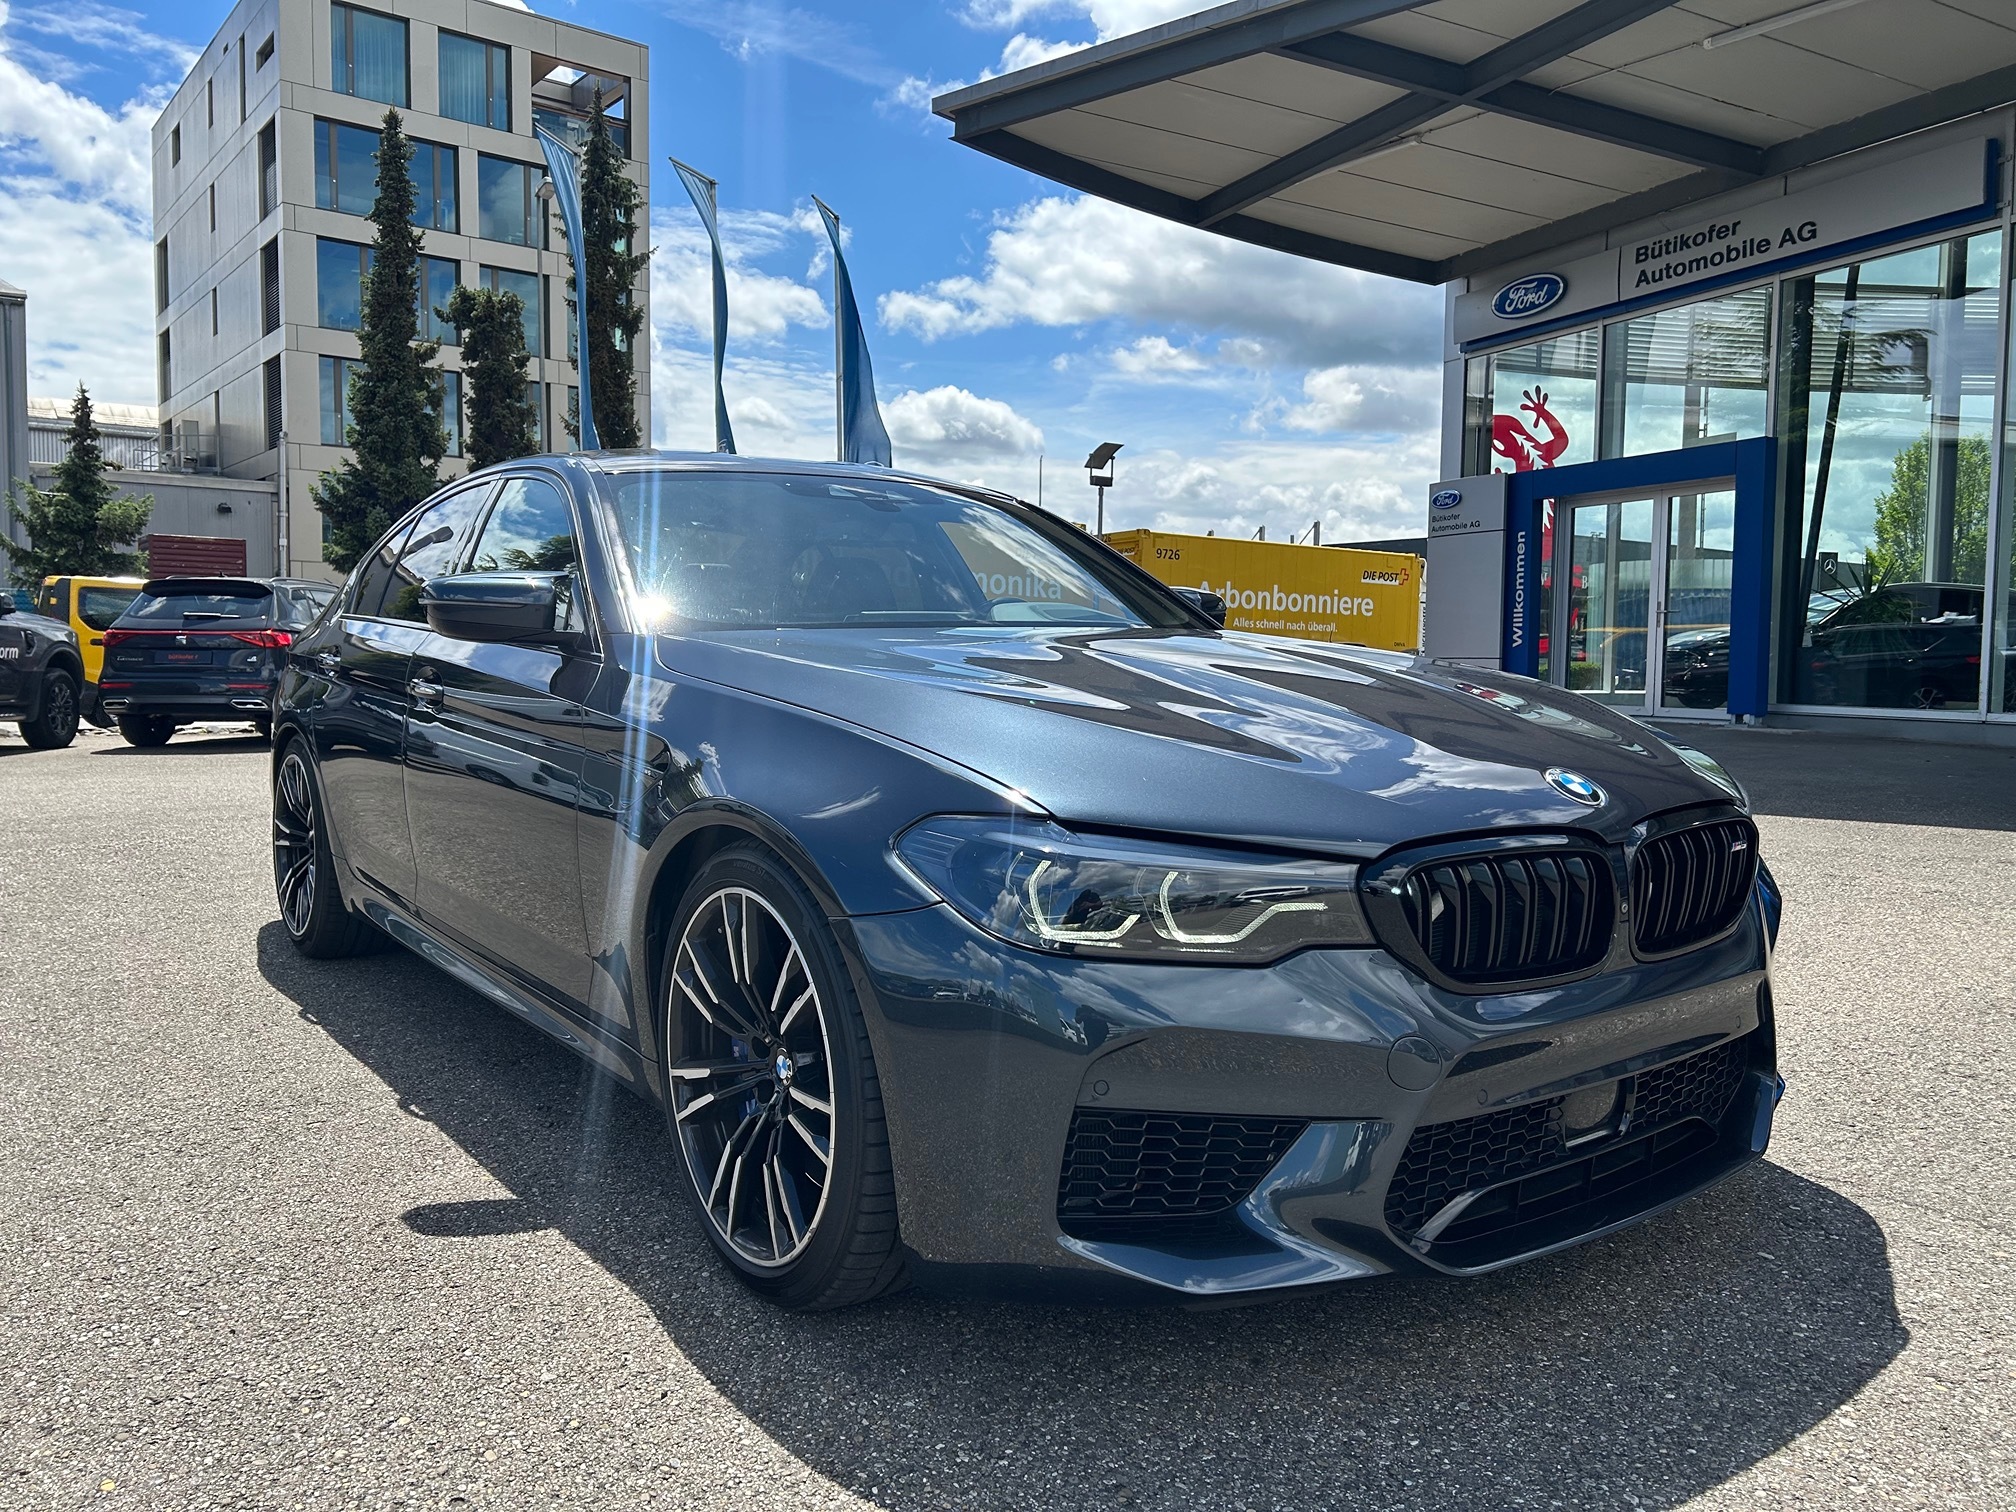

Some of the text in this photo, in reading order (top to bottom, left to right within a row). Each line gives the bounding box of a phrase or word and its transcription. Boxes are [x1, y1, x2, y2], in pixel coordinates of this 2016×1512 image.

[1635, 220, 1741, 264] Bütikofer
[1635, 221, 1817, 288] Automobile AG
[1505, 281, 1548, 312] Ford
[1431, 520, 1480, 533] Automobile AG
[1156, 548, 1180, 560] 9726
[1362, 570, 1399, 583] DIE POST
[1512, 531, 1526, 647] Willkommen
[1233, 617, 1338, 632] Alles schnell nach überall.
